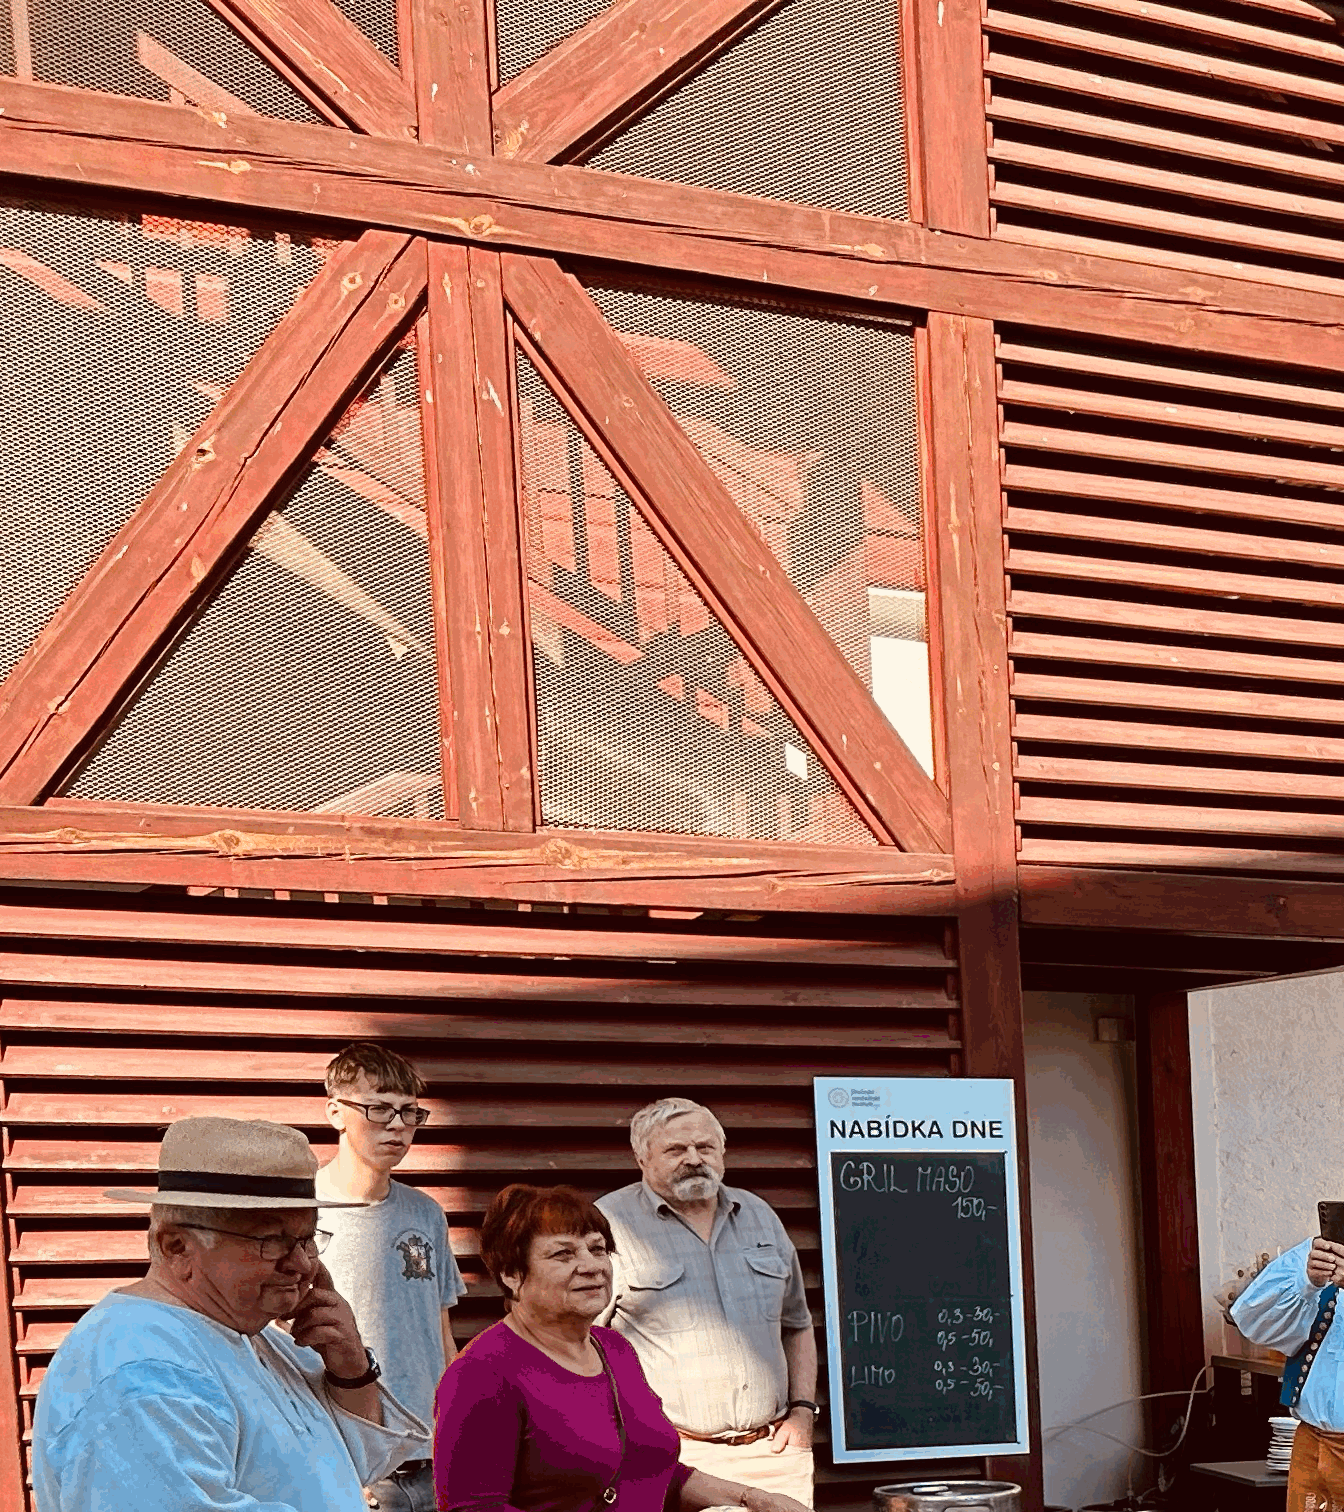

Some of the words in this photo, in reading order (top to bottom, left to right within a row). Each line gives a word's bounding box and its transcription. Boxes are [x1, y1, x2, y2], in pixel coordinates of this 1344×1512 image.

[829, 1114, 944, 1139] NABÍDKA
[952, 1120, 1004, 1139] DNE
[840, 1160, 908, 1193] GRIL
[917, 1165, 975, 1193] MASO
[951, 1196, 998, 1221] 150,-
[848, 1310, 904, 1344] PIVO
[850, 1365, 896, 1388] LIMO
